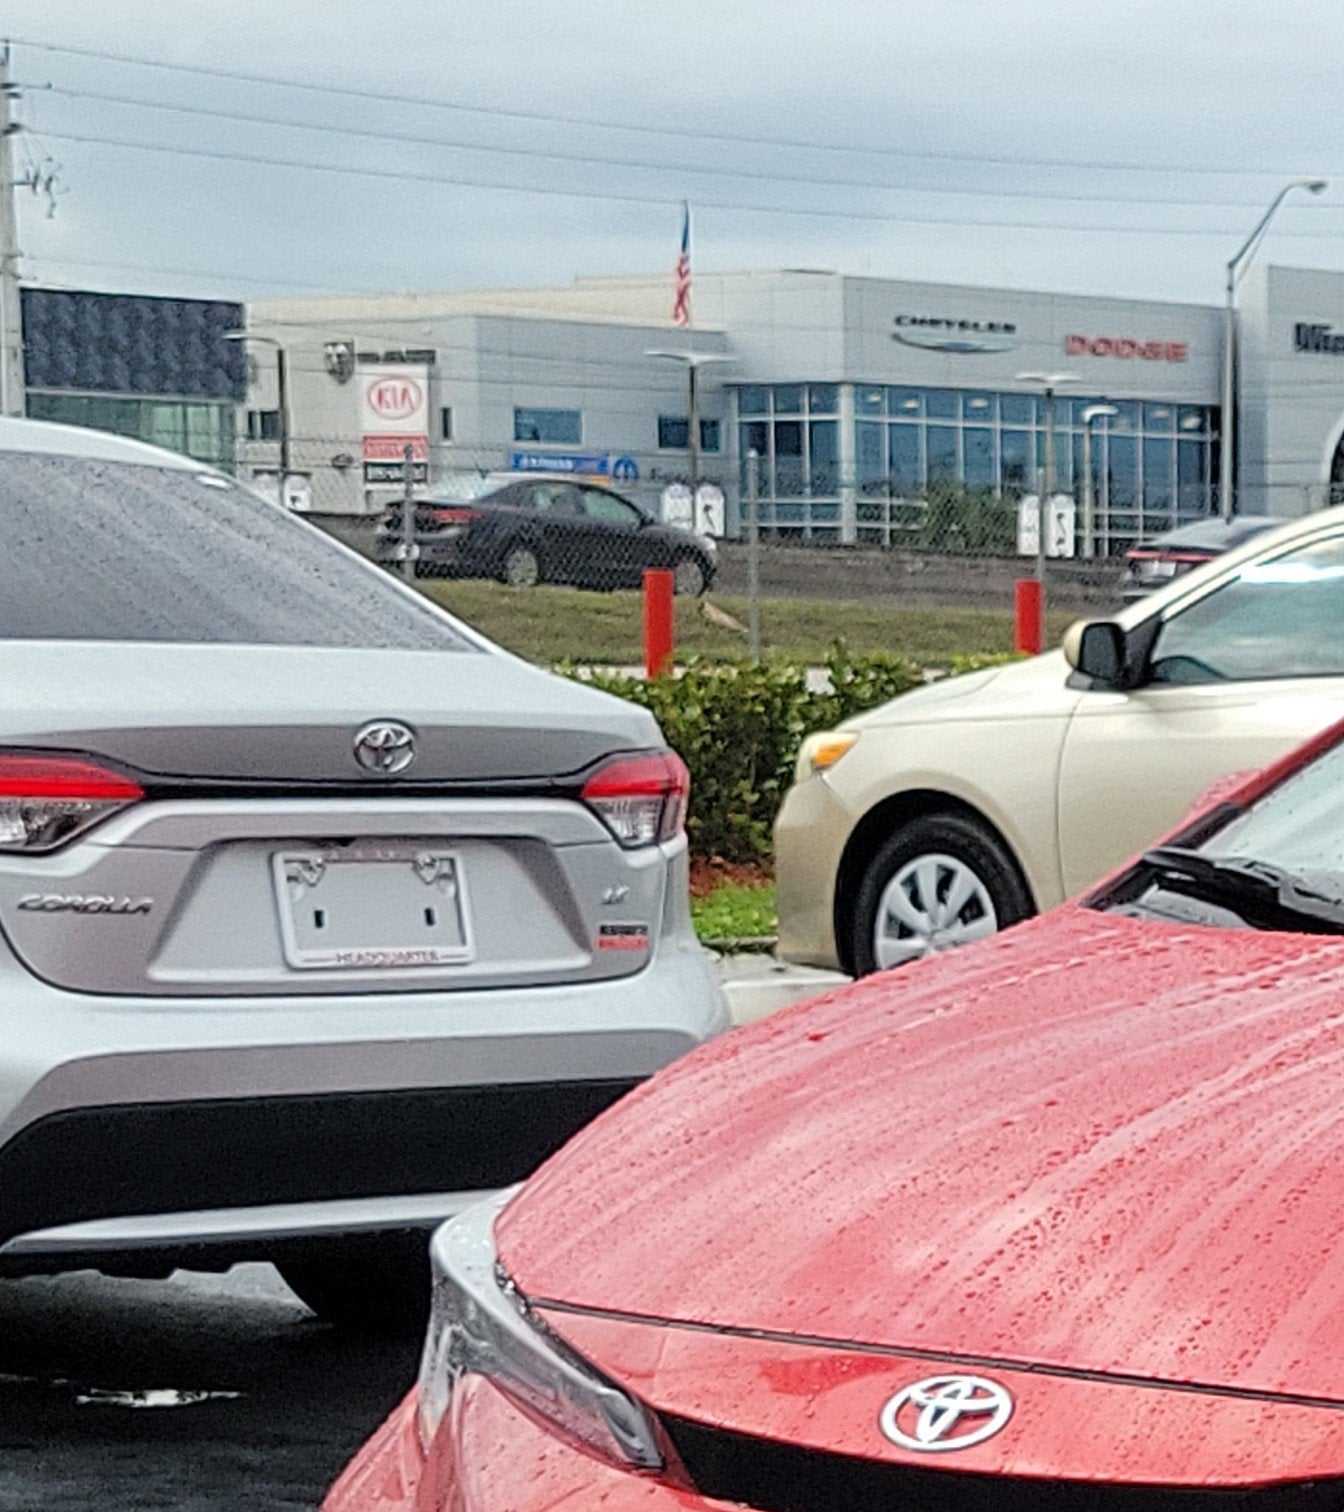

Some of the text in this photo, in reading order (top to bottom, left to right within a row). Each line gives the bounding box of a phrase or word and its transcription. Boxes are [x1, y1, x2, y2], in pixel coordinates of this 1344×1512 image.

[1065, 334, 1189, 363] DODGE
[377, 386, 417, 412] KIA
[16, 894, 155, 916] COROLLA
